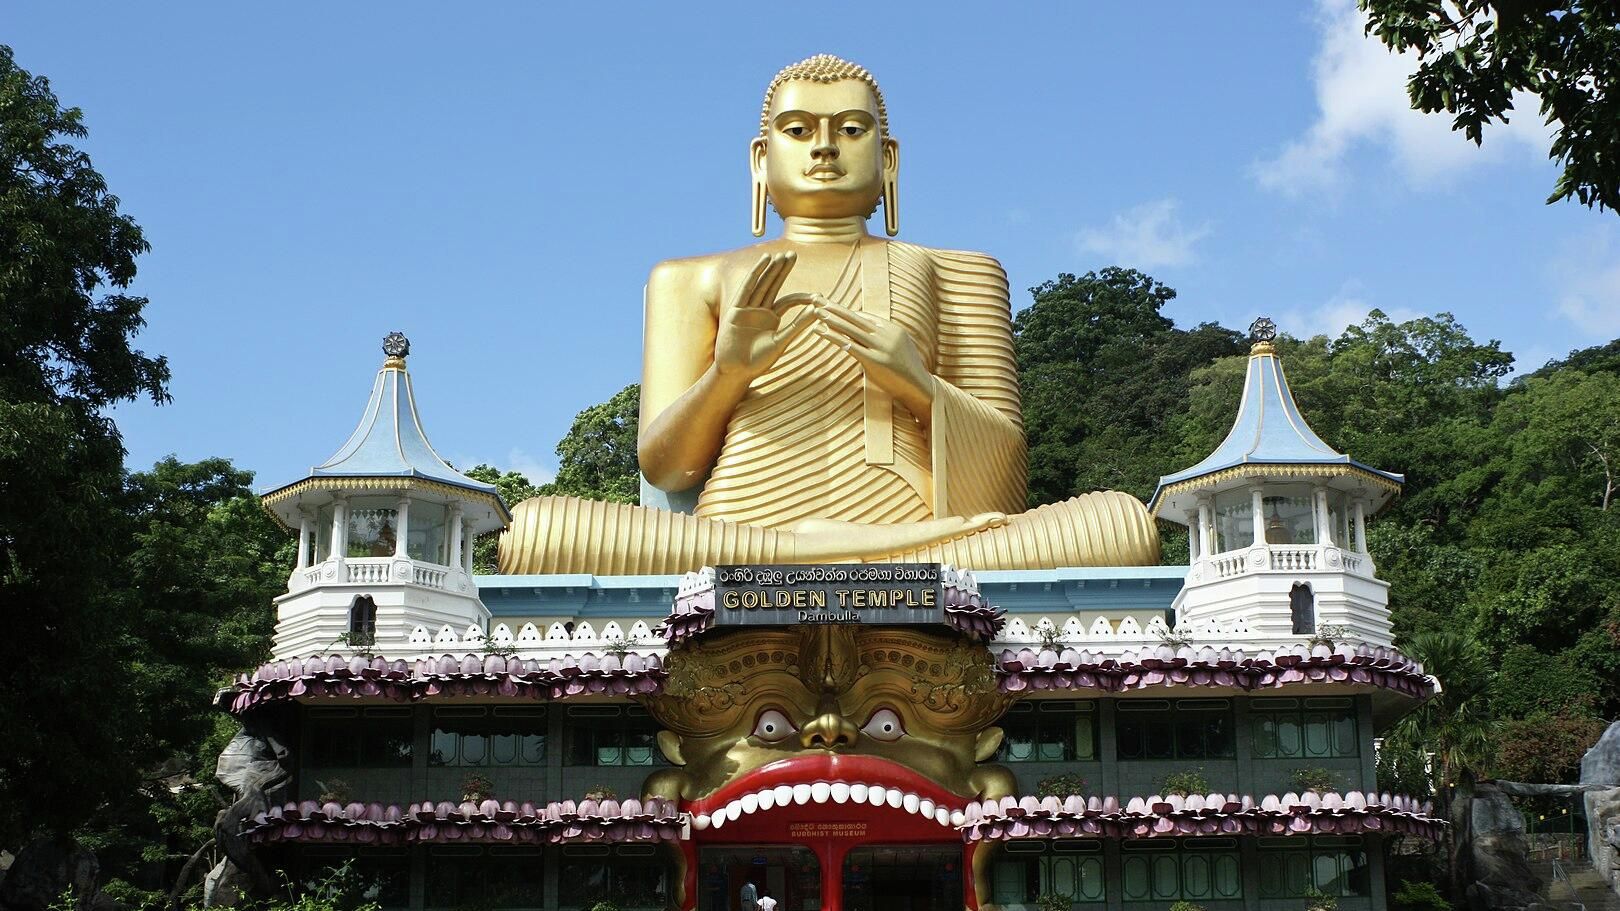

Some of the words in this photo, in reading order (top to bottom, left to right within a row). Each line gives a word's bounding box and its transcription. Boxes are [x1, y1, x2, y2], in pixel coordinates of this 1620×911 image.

[723, 590, 826, 608] GOLDEN
[835, 588, 936, 607] TEMPLE
[798, 611, 860, 623] Dambulla
[791, 830, 829, 838] BUDDHIST
